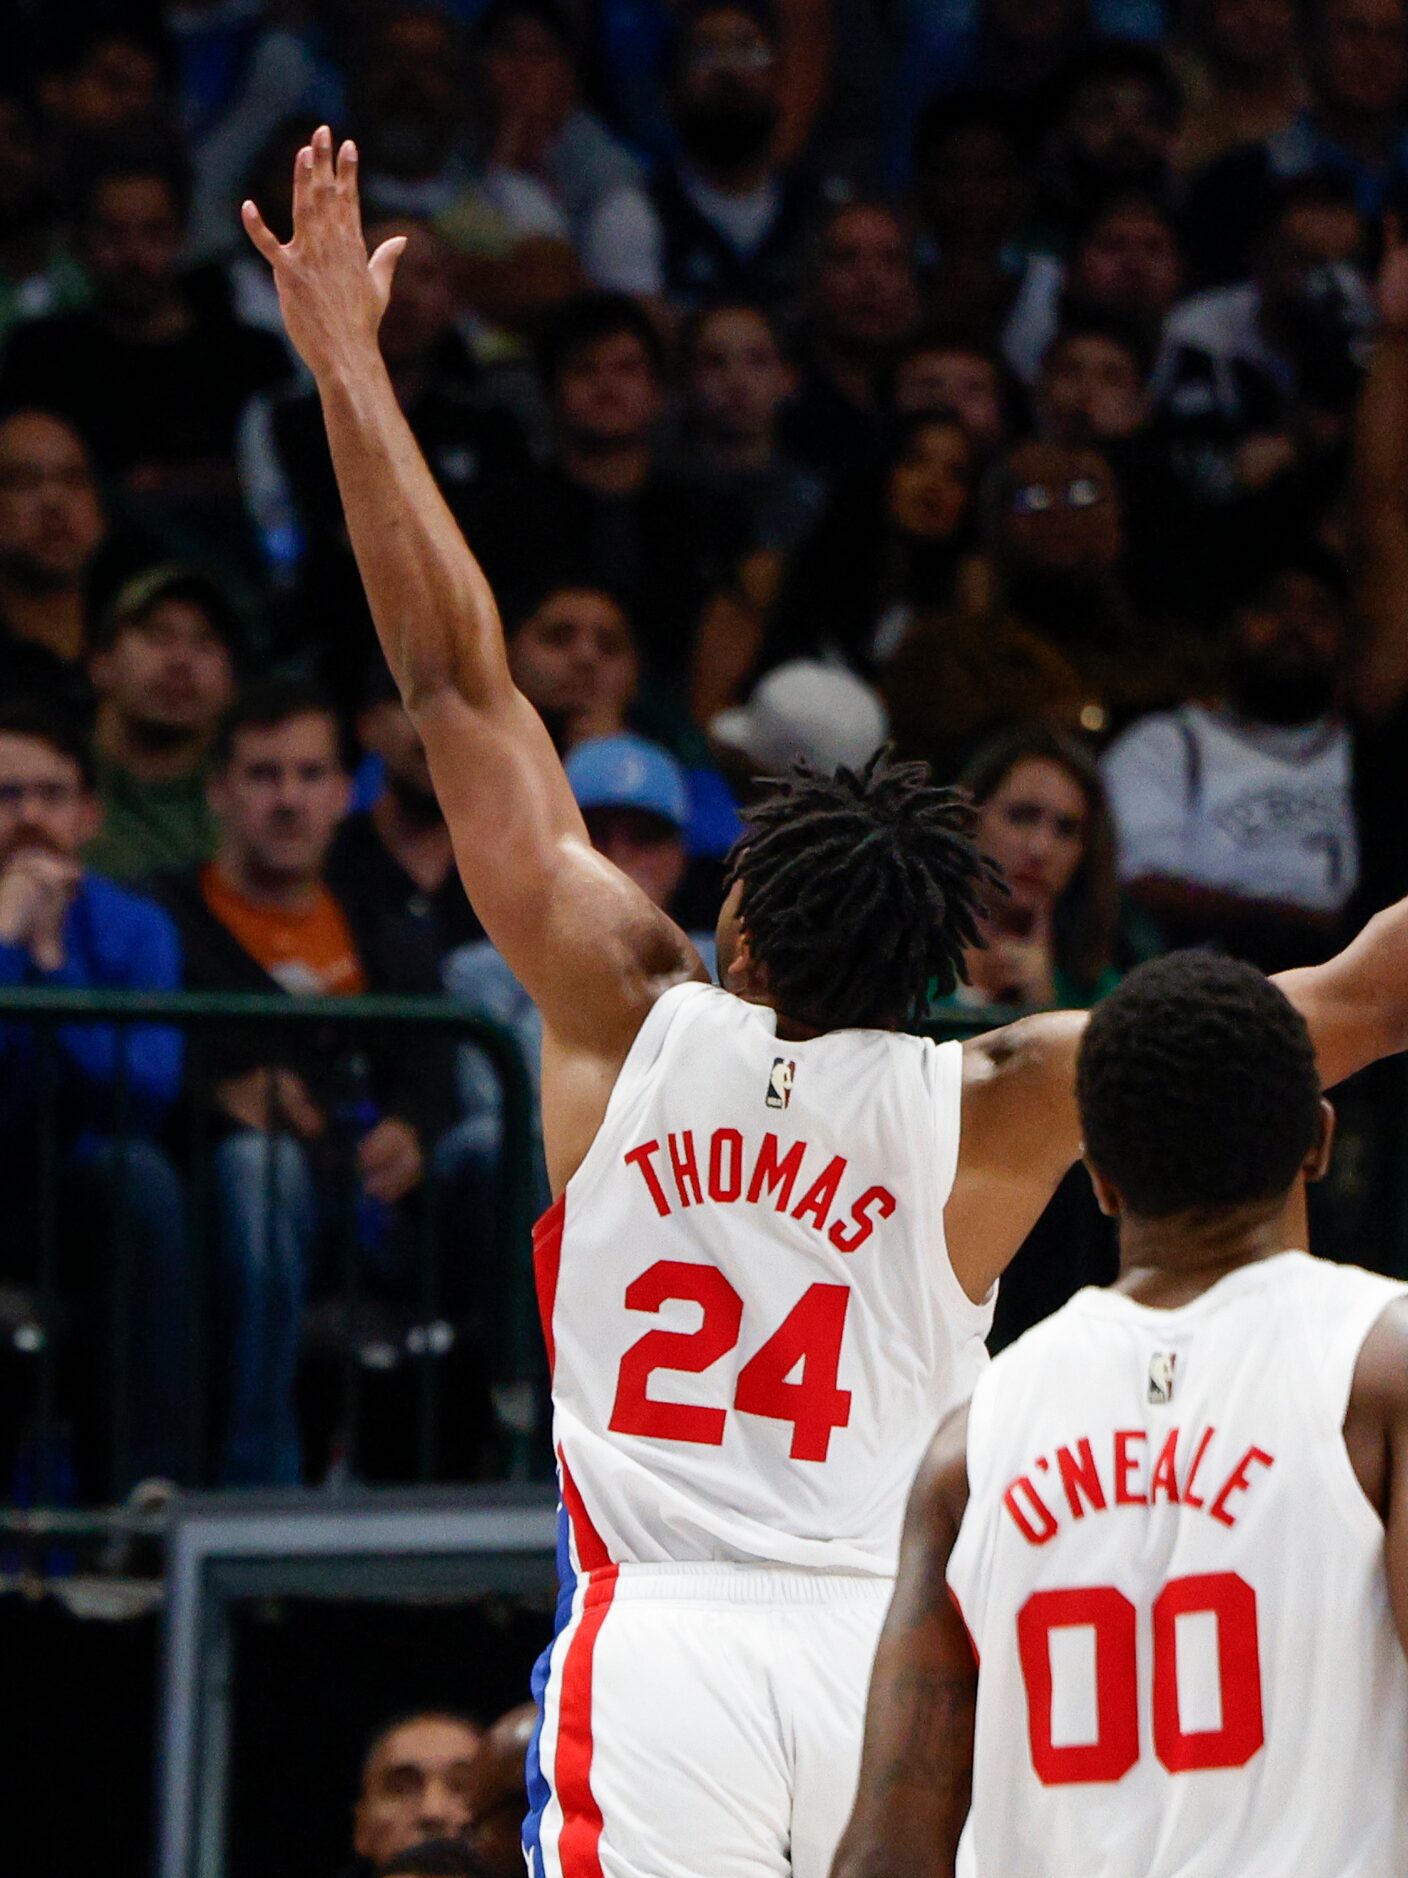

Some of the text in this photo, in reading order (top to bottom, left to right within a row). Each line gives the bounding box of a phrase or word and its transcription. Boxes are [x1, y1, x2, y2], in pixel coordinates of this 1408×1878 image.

[624, 1128, 896, 1253] THOMAS
[608, 1260, 852, 1462] 24
[1003, 1427, 1274, 1546] O'NEALE
[1017, 1571, 1264, 1787] 00
